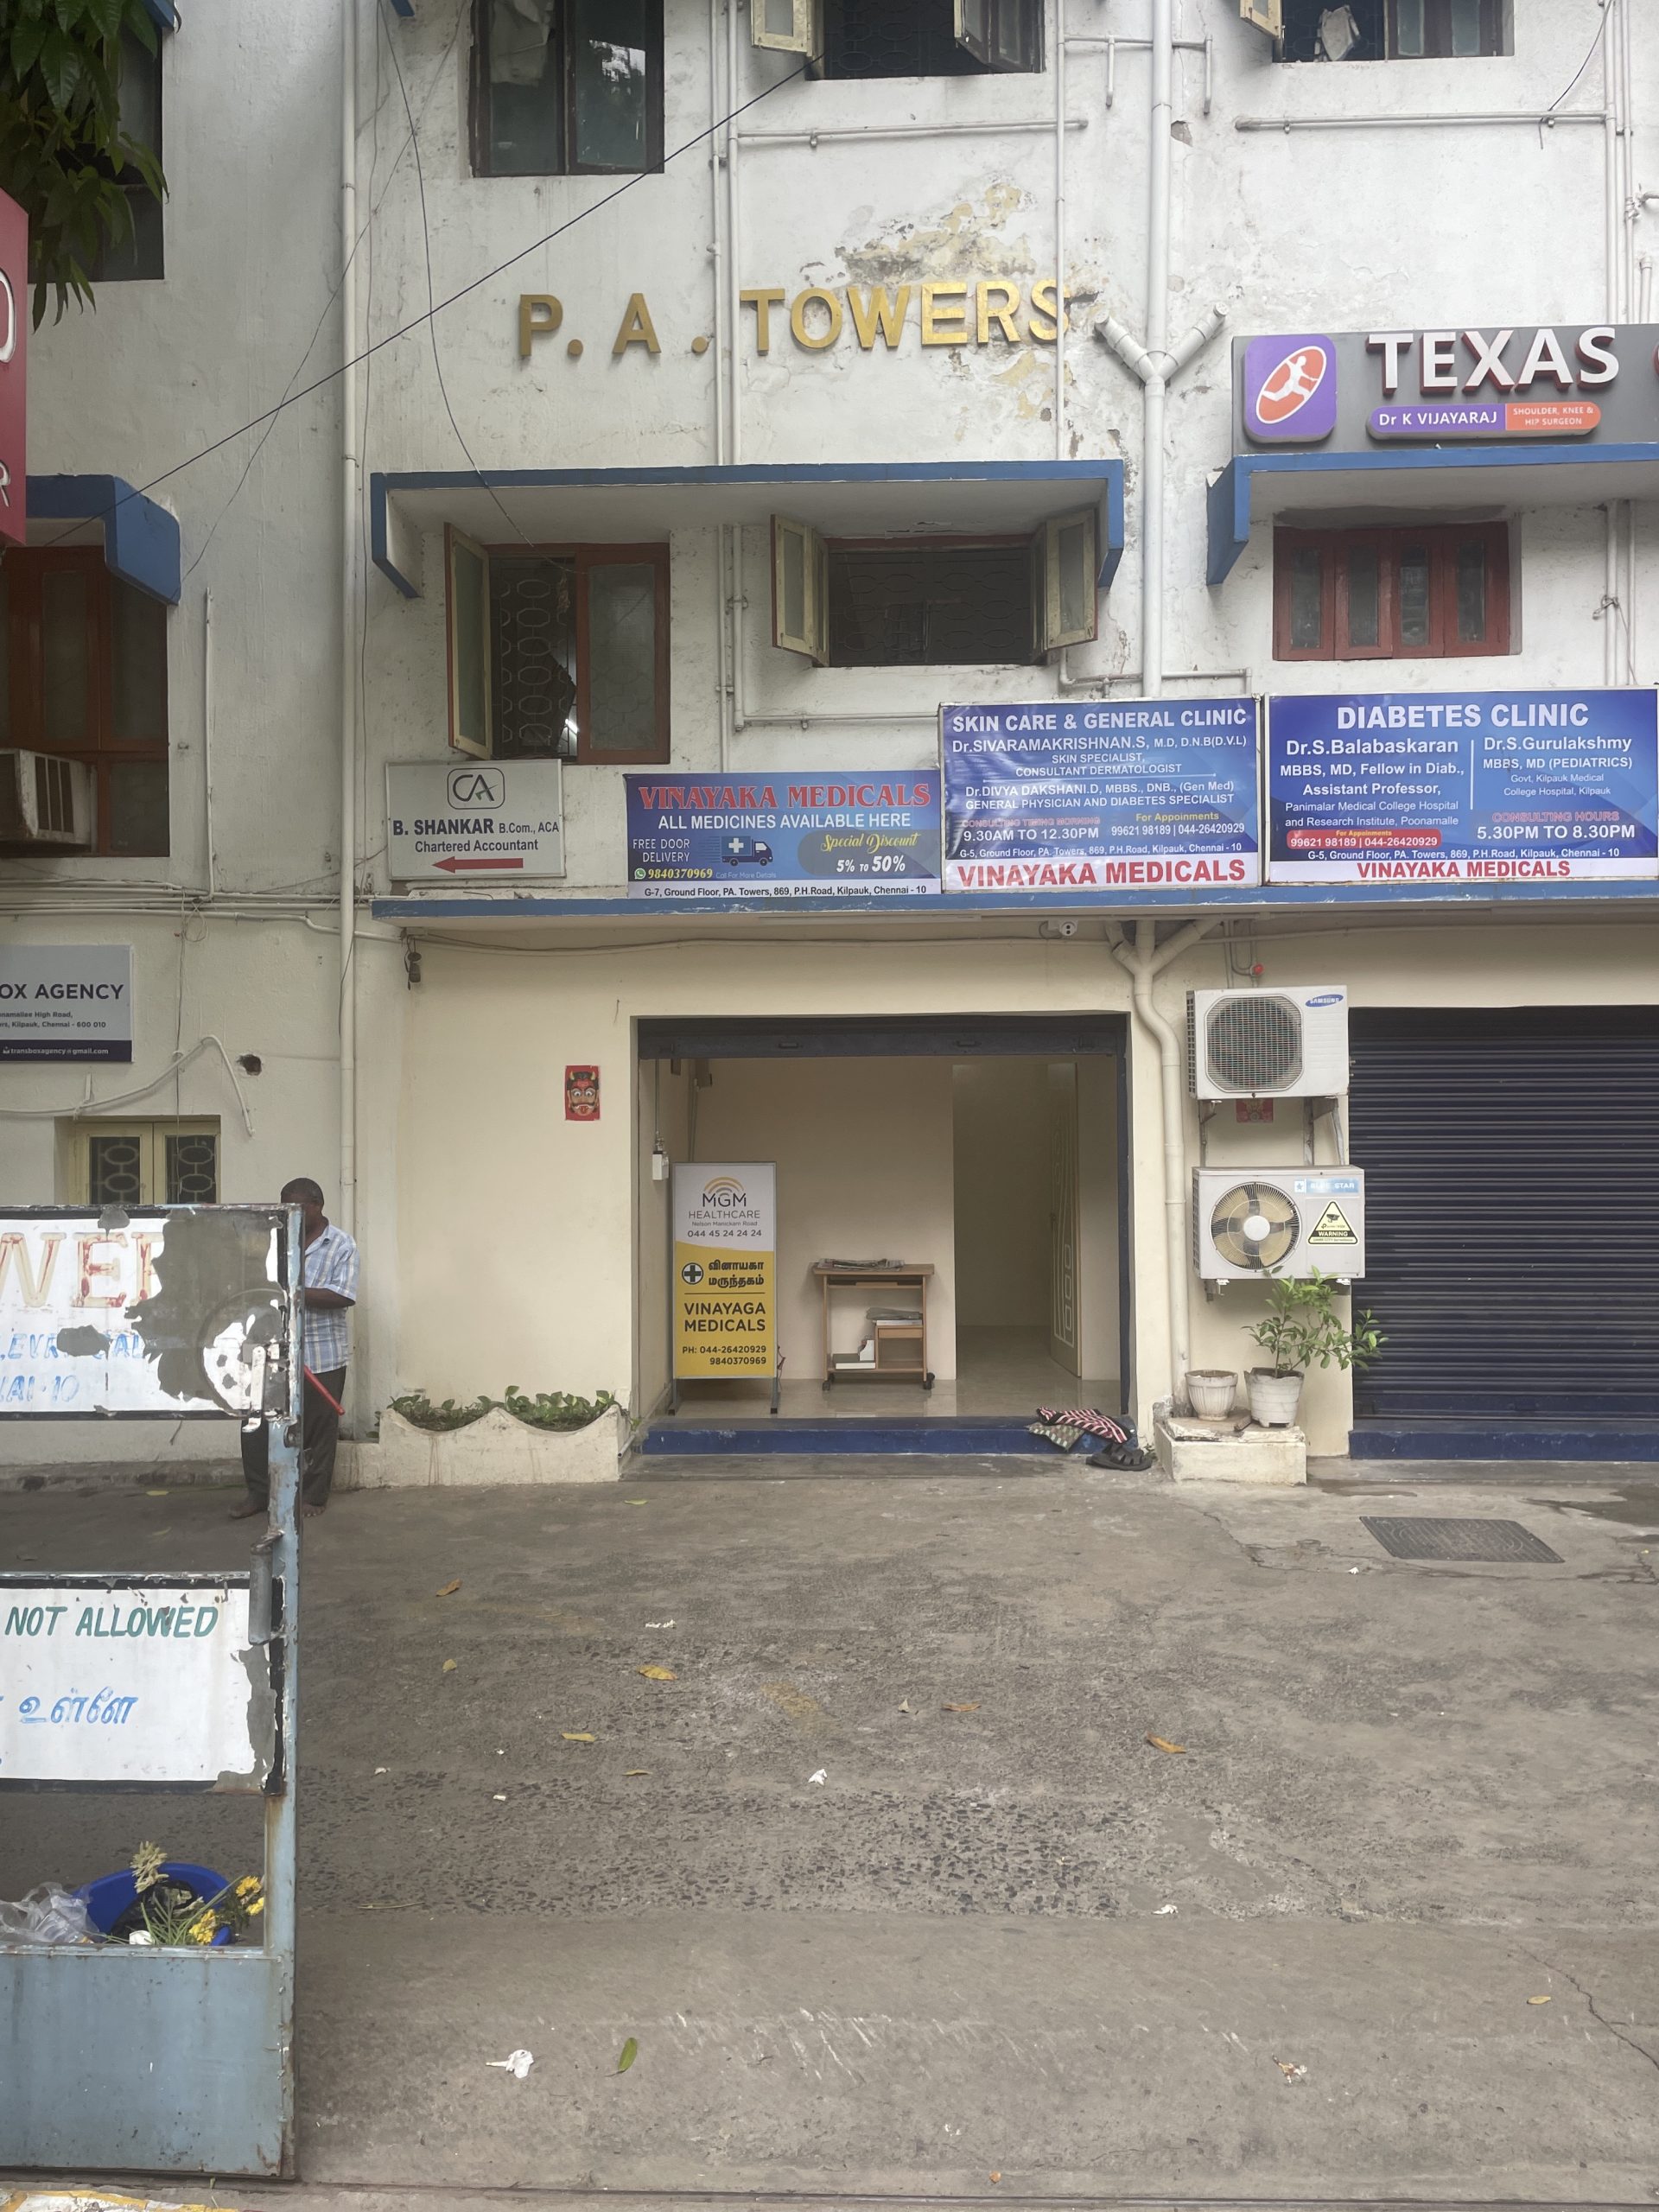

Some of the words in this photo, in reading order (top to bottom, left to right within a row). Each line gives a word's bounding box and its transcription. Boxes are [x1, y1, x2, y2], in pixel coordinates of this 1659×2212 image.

[739, 278, 1071, 355] TOWERS
[1367, 327, 1619, 395] TEXAS
[1379, 413, 1396, 425] Dr
[1402, 413, 1412, 424] K
[1418, 410, 1497, 424] VIJAYARAJ
[1562, 406, 1584, 415] KNEE
[1542, 417, 1582, 426] SURGEON
[952, 715, 999, 733] SKIN
[1006, 714, 1057, 731] CARE
[1064, 713, 1077, 730] &
[1084, 710, 1175, 729] GENERAL
[1180, 709, 1247, 727] CLINIC
[1338, 704, 1482, 729] DIABETES
[1491, 702, 1590, 728] CLINIC
[952, 736, 1150, 753] Dr.SIVARAMAKRISHNAN.S,
[1154, 737, 1178, 748] M.D,
[1180, 736, 1247, 748] D.N.B(D.V.L)
[1287, 737, 1459, 755] Dr.S.Balabaskaran
[1484, 735, 1632, 752] Dr.S.Gurulakshmy
[1052, 754, 1077, 764] SKIN
[1080, 753, 1145, 764] SPECIALIST,
[1483, 758, 1522, 770] MBBS,
[1526, 759, 1546, 768] MD
[1548, 757, 1632, 771] (PEDIATRICS)
[1015, 766, 1087, 777] CONSULTANT
[1090, 764, 1183, 775] DERMATOLOGIST
[1280, 765, 1325, 777] MBBS,
[1330, 764, 1356, 776] MD,
[1360, 763, 1405, 775] Fellow
[1409, 763, 1421, 774] in
[1426, 762, 1465, 776] Diab.,
[1536, 774, 1568, 784] Kilpauk
[1570, 773, 1605, 782] Medical
[965, 785, 1019, 797] Dr.DIVYA
[1021, 784, 1103, 796] DAKSHANI.D,
[1105, 784, 1144, 794] MBBS.,
[1147, 783, 1177, 793] DNB.,
[1179, 782, 1205, 793] (Gen
[1208, 781, 1234, 791] Med)
[1302, 784, 1368, 796] Assistant
[1371, 783, 1441, 796] Professor,
[1503, 787, 1536, 797] College
[1579, 786, 1611, 796] Kilpauk
[639, 786, 779, 810] VINAYAKA
[787, 783, 931, 809] MEDICALS
[965, 799, 1019, 810] GENERAL
[1021, 798, 1081, 809] PHYSICIAN
[1084, 798, 1108, 807] AND
[1110, 796, 1166, 806] DIABETES
[1168, 794, 1234, 804] SPECIALIST
[1285, 802, 1335, 811] Panimalar
[1338, 801, 1376, 810] Medical
[1378, 801, 1415, 812] College
[1419, 800, 1459, 811] Hospital
[658, 816, 687, 830] ALL
[690, 815, 776, 829] MEDICINES
[780, 813, 865, 829] AVAILABLE
[868, 812, 912, 827] HERE
[1285, 817, 1304, 827] and
[1306, 817, 1354, 826] Research
[1357, 817, 1398, 827] Institute,
[1401, 816, 1459, 826] Poonamalle
[1492, 811, 1573, 822] CONSULTING
[1575, 810, 1620, 821] HOURS
[393, 819, 409, 836] B.
[414, 818, 494, 836] SHANKAR
[537, 821, 559, 833] ACA
[1111, 825, 1140, 836] 99621
[1141, 824, 1171, 836] 98189
[1178, 823, 1245, 835] 044-26420929
[1477, 826, 1539, 839] 5.30PM
[1543, 825, 1567, 838] TO
[1573, 824, 1635, 838] 8.30PM
[963, 830, 1014, 842] 9.30AM
[1017, 829, 1037, 841] TO
[1040, 828, 1099, 840] 12.30PM
[1290, 837, 1322, 847] 99621
[1325, 837, 1357, 847] 98189
[1364, 836, 1438, 847] 044-26420929
[415, 840, 471, 853] Chartered
[474, 839, 538, 852] Accountant
[632, 839, 657, 849] FREE
[660, 838, 690, 849] DOOR
[822, 832, 864, 853] Special
[867, 832, 922, 855] Discount
[643, 851, 690, 862] DELIVERY
[1307, 851, 1327, 861] G-5,
[1329, 850, 1363, 860] Ground
[1366, 850, 1392, 860] Floor,
[1394, 850, 1409, 859] PA.
[1411, 850, 1448, 860] Towers,
[1450, 849, 1471, 860] 869,
[1472, 849, 1518, 860] P.H.Road,
[1520, 849, 1558, 859] Kilpauk,
[1560, 848, 1600, 857] Chennai
[1608, 848, 1619, 856] 10
[836, 859, 855, 873] 5%
[871, 855, 906, 873] 50%
[1357, 861, 1460, 879] VINAYAKA
[1466, 860, 1571, 878] MEDICALS
[648, 868, 713, 880] 9840370969
[957, 862, 1097, 887] VINAYAKA
[1105, 859, 1245, 884] MEDICALS
[644, 887, 662, 897] G-7,
[664, 887, 696, 897] Ground
[697, 887, 721, 898] Floor,
[723, 887, 737, 897] PA.
[739, 887, 772, 897] Towers,
[773, 887, 792, 897] 869,
[794, 887, 836, 896] P.H.Road,
[837, 886, 872, 895] Kilpauk,
[874, 886, 909, 894] Chennai
[916, 885, 926, 893] 10
[35, 983, 124, 1000] AGENCY
[702, 1192, 747, 1208] MGM
[688, 1210, 761, 1219] HEALTHCARE
[709, 1274, 765, 1288] மருந்தகம்
[684, 1302, 766, 1315] VINAYAGA
[684, 1319, 766, 1332] MEDICALS
[682, 1345, 697, 1354] PH:
[699, 1344, 766, 1354] 044-26420929
[709, 1357, 766, 1365] 9840370969
[4, 1606, 68, 1637] NOT
[75, 1605, 219, 1638] ALLOWED
